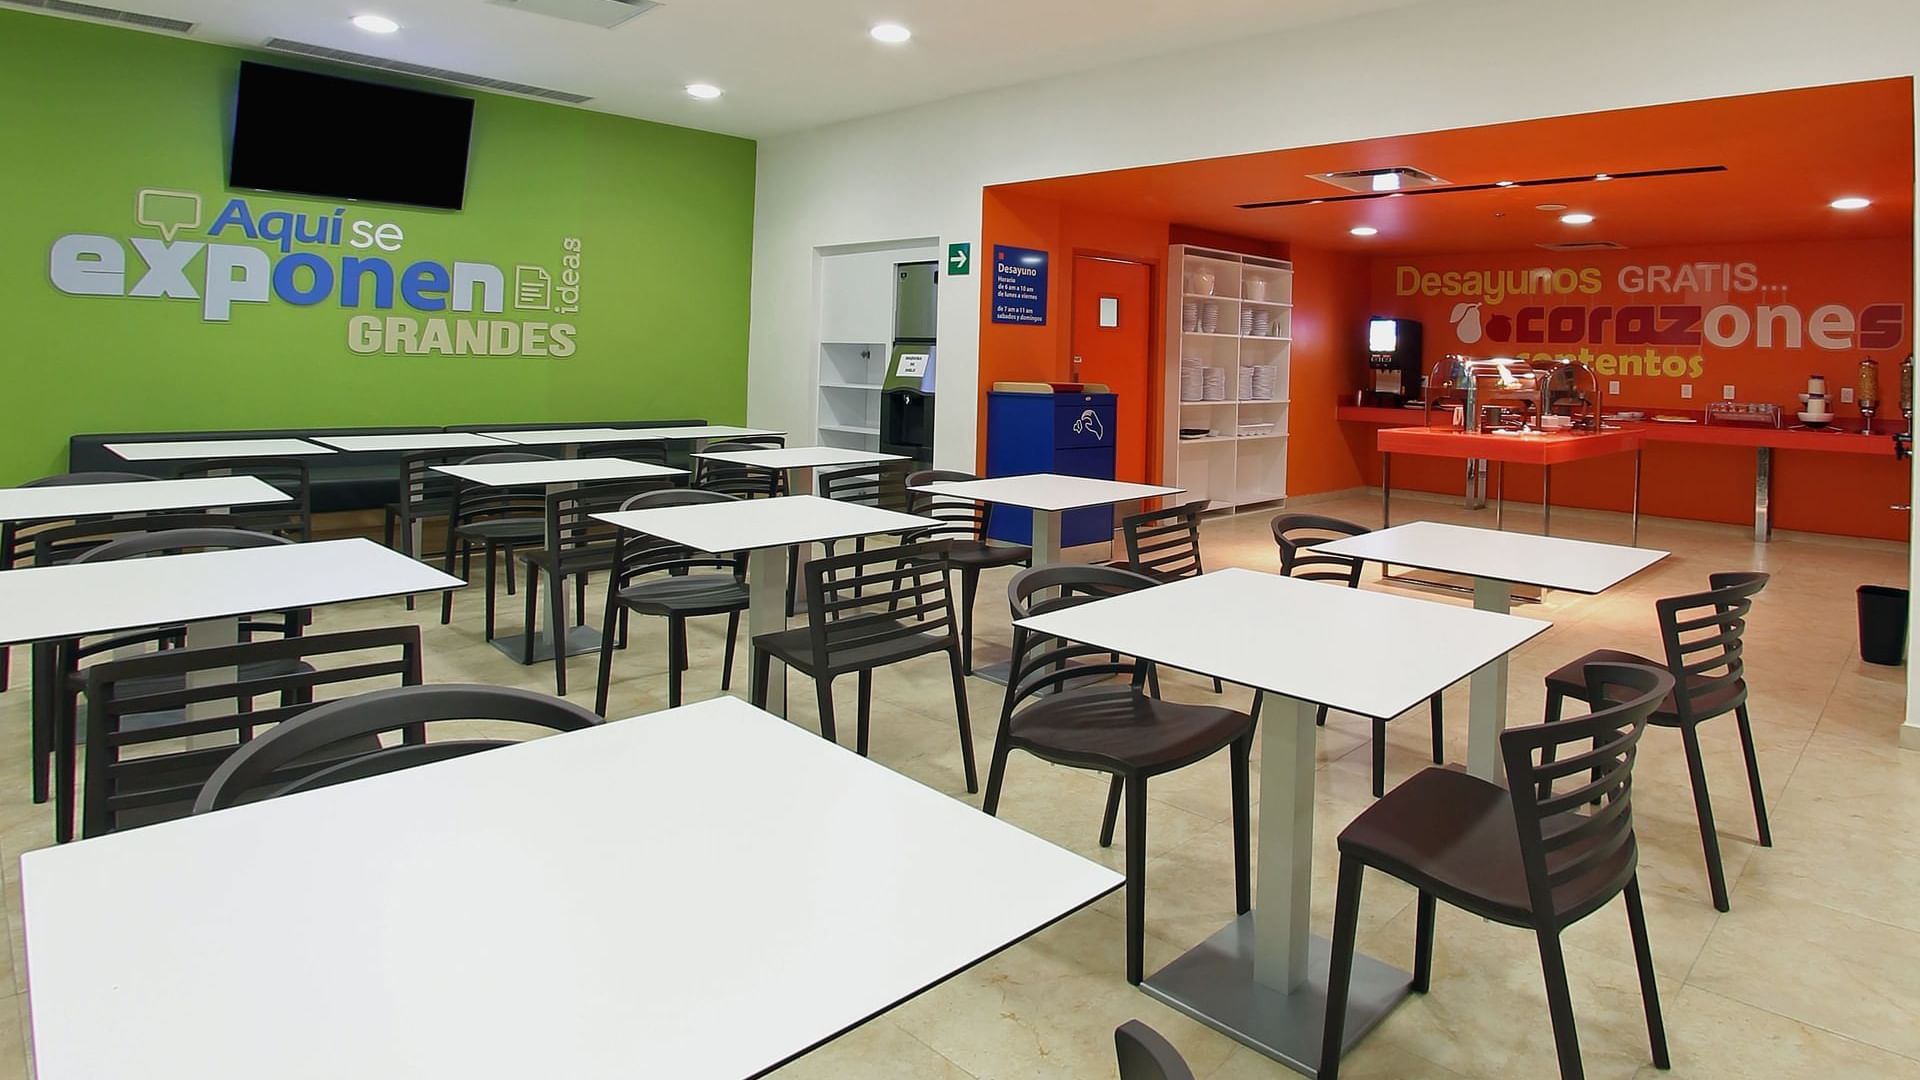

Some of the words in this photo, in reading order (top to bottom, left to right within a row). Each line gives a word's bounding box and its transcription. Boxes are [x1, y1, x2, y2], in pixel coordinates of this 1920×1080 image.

[207, 198, 346, 252] Aquí
[349, 218, 404, 252] se
[49, 233, 505, 322] exponen
[554, 237, 581, 314] ideas
[998, 263, 1037, 277] Desayuno
[1396, 265, 1602, 305] Desayunos
[346, 314, 577, 357] GRANDES
[1516, 303, 1905, 350] corazones
[1518, 347, 1704, 378] tentos
